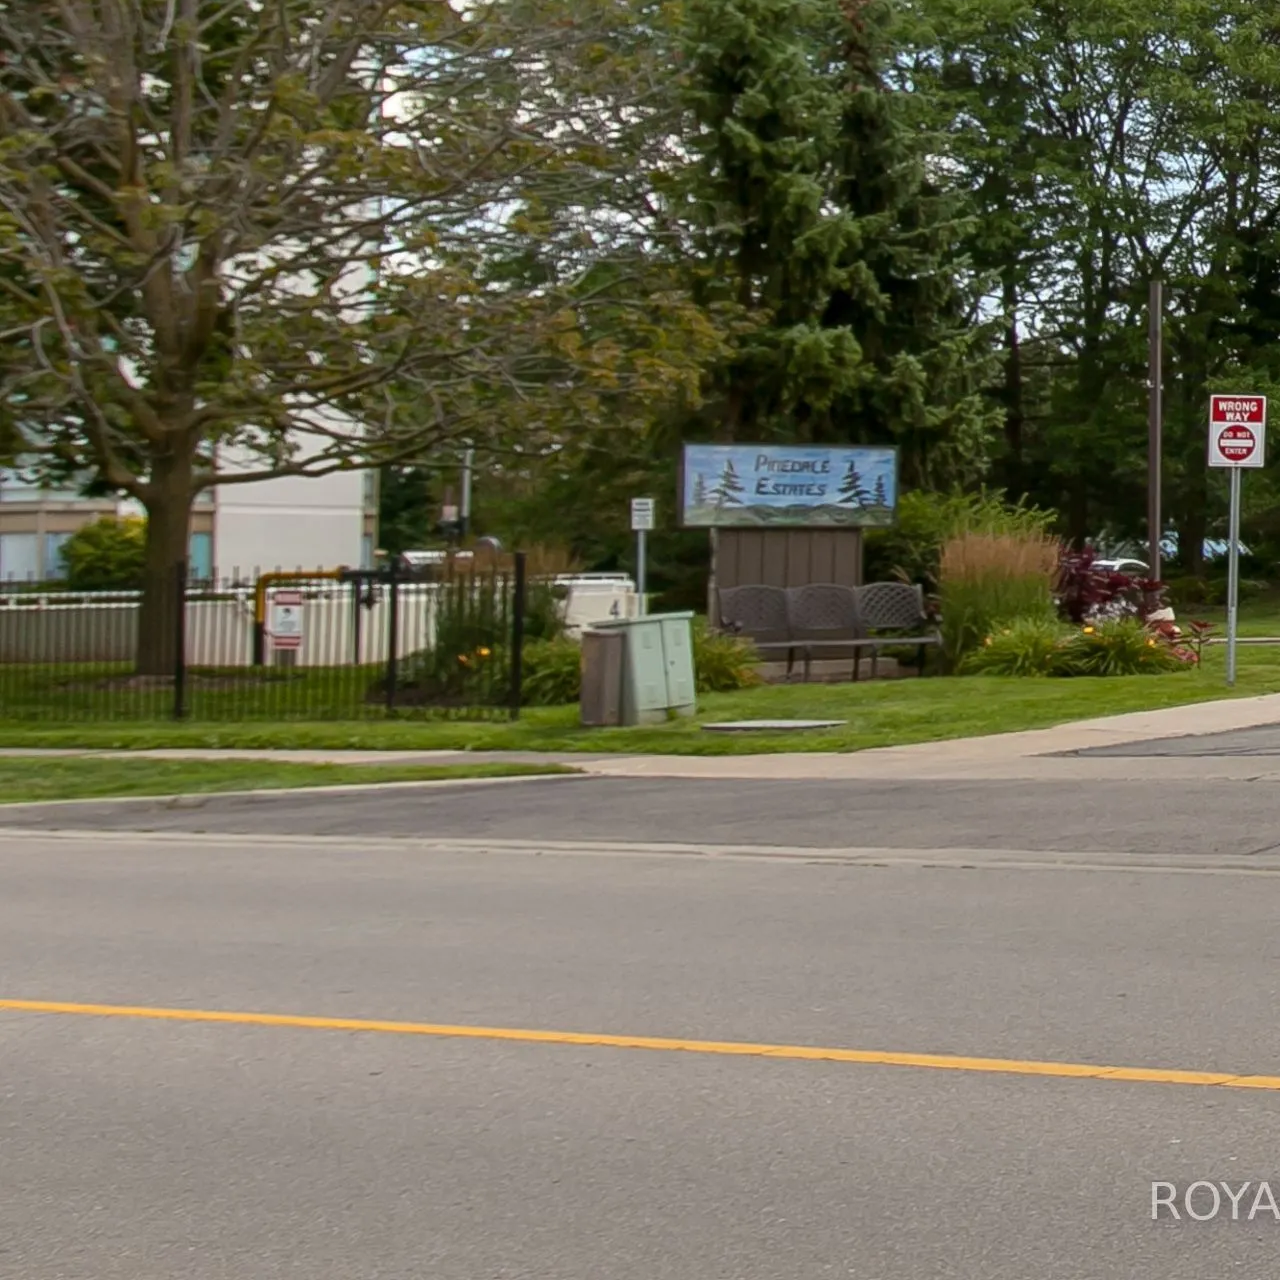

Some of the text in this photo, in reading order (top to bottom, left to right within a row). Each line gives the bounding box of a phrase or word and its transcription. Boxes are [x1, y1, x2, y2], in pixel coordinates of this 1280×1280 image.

[1218, 401, 1258, 412] WRONG
[1225, 412, 1250, 422] WAY
[755, 477, 828, 496] ESTATES
